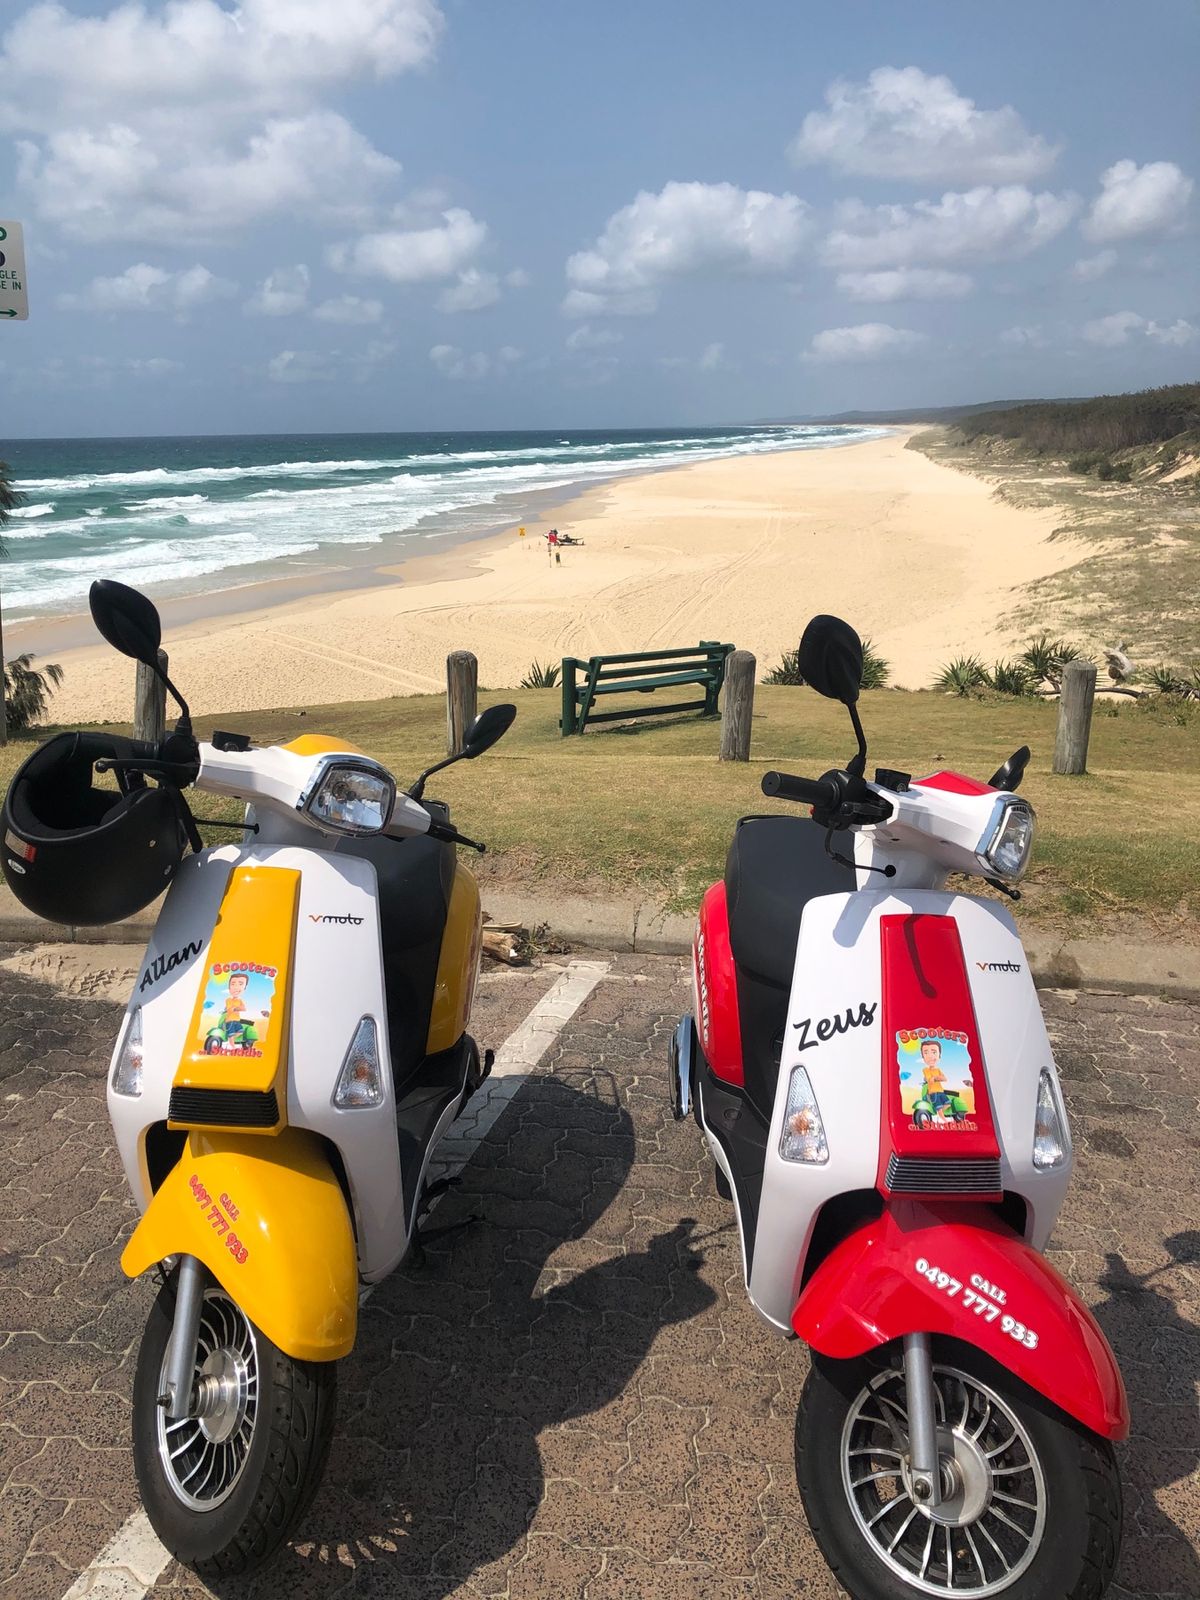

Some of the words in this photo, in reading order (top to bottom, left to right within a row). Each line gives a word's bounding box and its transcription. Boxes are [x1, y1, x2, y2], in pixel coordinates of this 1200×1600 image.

[12, 281, 22, 290] IN
[139, 939, 203, 993] Allan
[213, 962, 277, 978] Scooters
[793, 1002, 877, 1051] Zeus
[899, 1027, 967, 1044] Scooters
[189, 1174, 213, 1210] 0497
[207, 1205, 230, 1236] 777
[225, 1232, 249, 1265] 933
[220, 1193, 240, 1222] CALL
[915, 1257, 963, 1298] 0497
[961, 1287, 1001, 1323] 777
[1000, 1314, 1039, 1350] 933
[969, 1273, 1007, 1306] CALL
